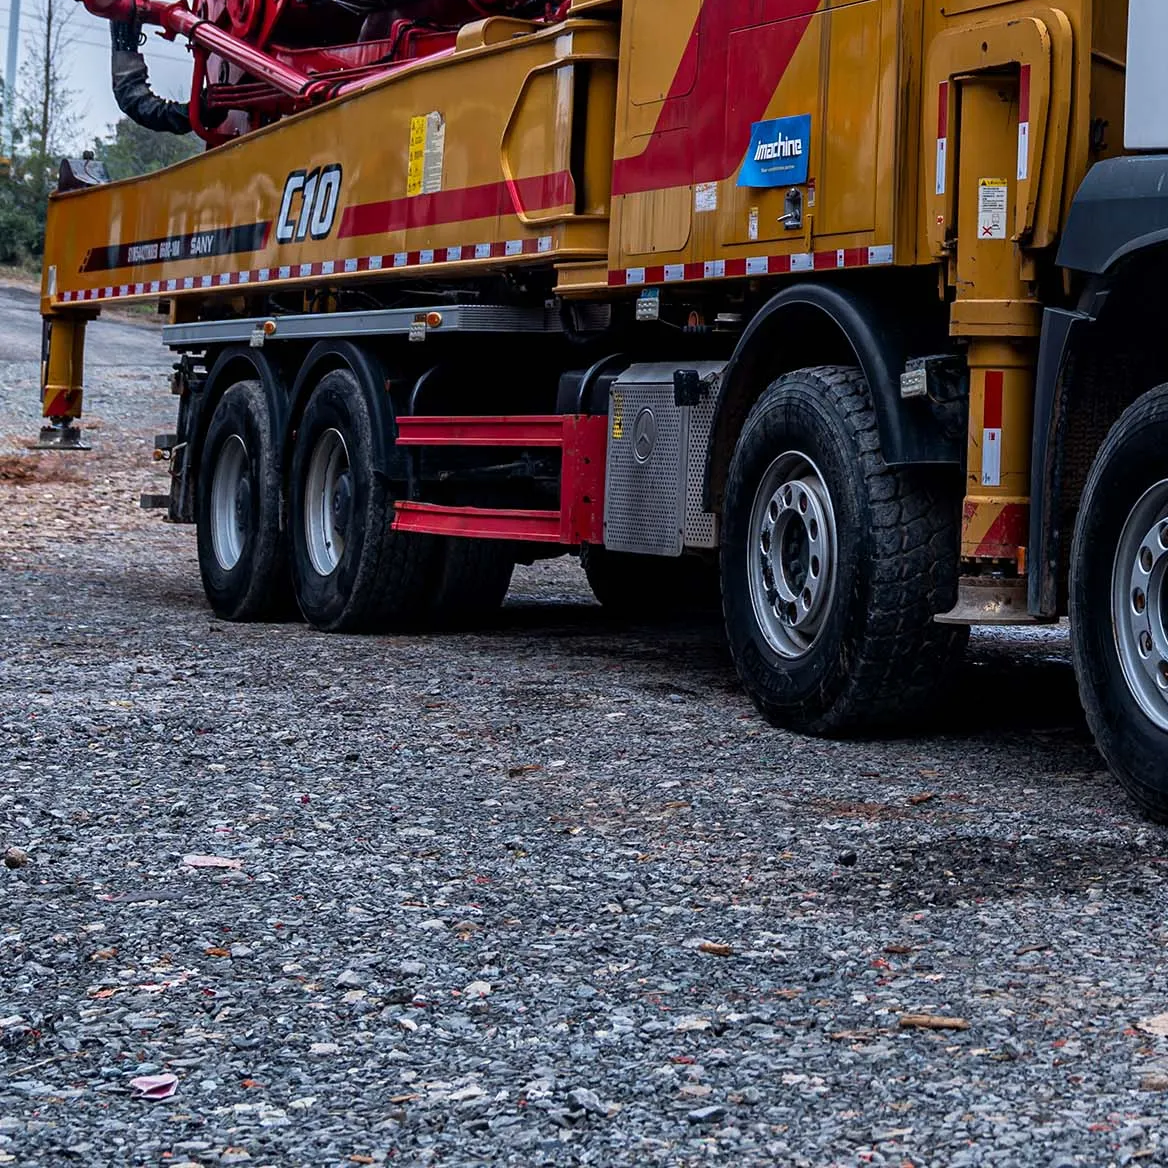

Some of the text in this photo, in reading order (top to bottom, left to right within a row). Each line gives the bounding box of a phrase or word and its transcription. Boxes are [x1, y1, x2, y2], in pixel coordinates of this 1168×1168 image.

[753, 131, 803, 161] imachine
[276, 163, 343, 245] C10
[190, 235, 214, 255] SANY
